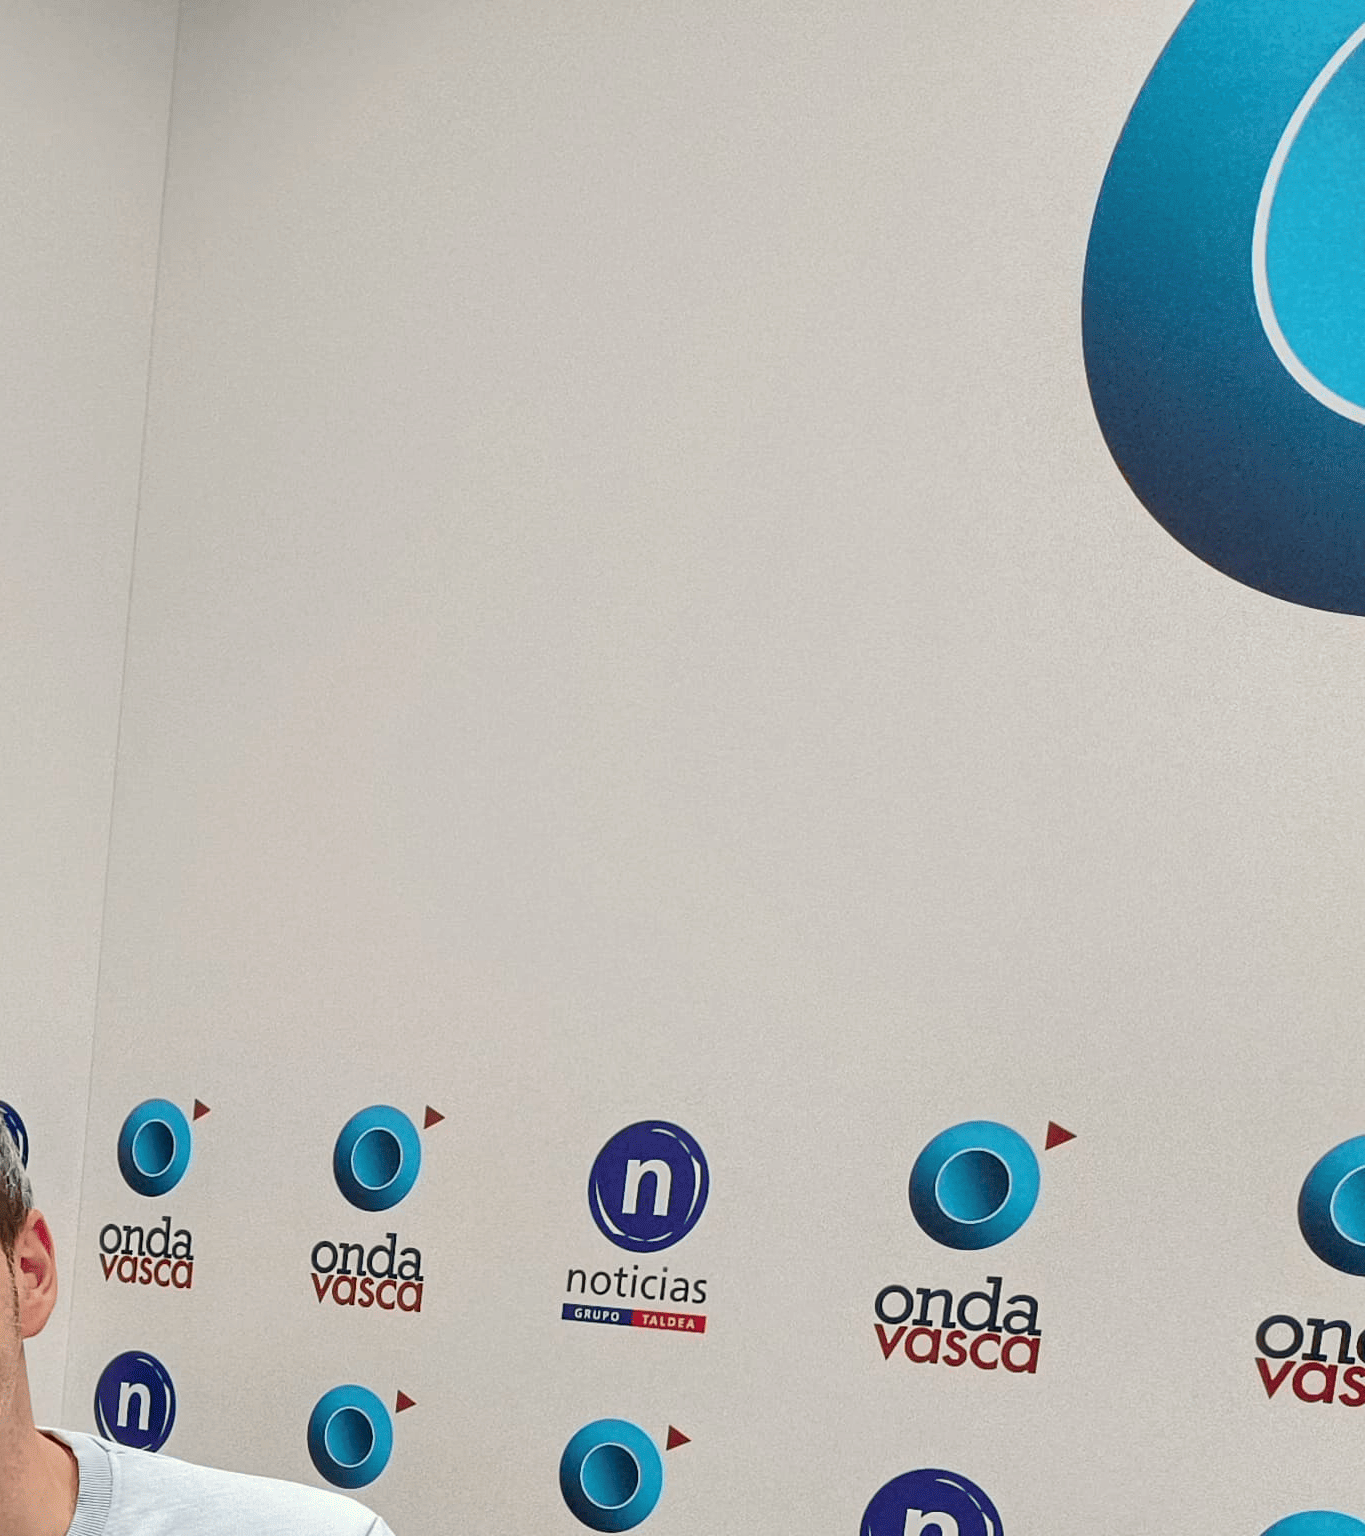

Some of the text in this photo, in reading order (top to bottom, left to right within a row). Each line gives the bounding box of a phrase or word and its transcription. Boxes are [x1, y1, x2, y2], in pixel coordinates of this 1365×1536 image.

[622, 1160, 671, 1216] n
[99, 1216, 194, 1260] onda
[311, 1233, 424, 1282] onda
[100, 1256, 194, 1290] vasca
[313, 1274, 423, 1312] vasca
[565, 1264, 707, 1304] noticias
[573, 1307, 697, 1331] GRUPO TALDEA
[875, 1276, 1041, 1336] onda
[875, 1324, 1041, 1373] vasca
[1255, 1314, 1365, 1364] on
[117, 1383, 150, 1430] n
